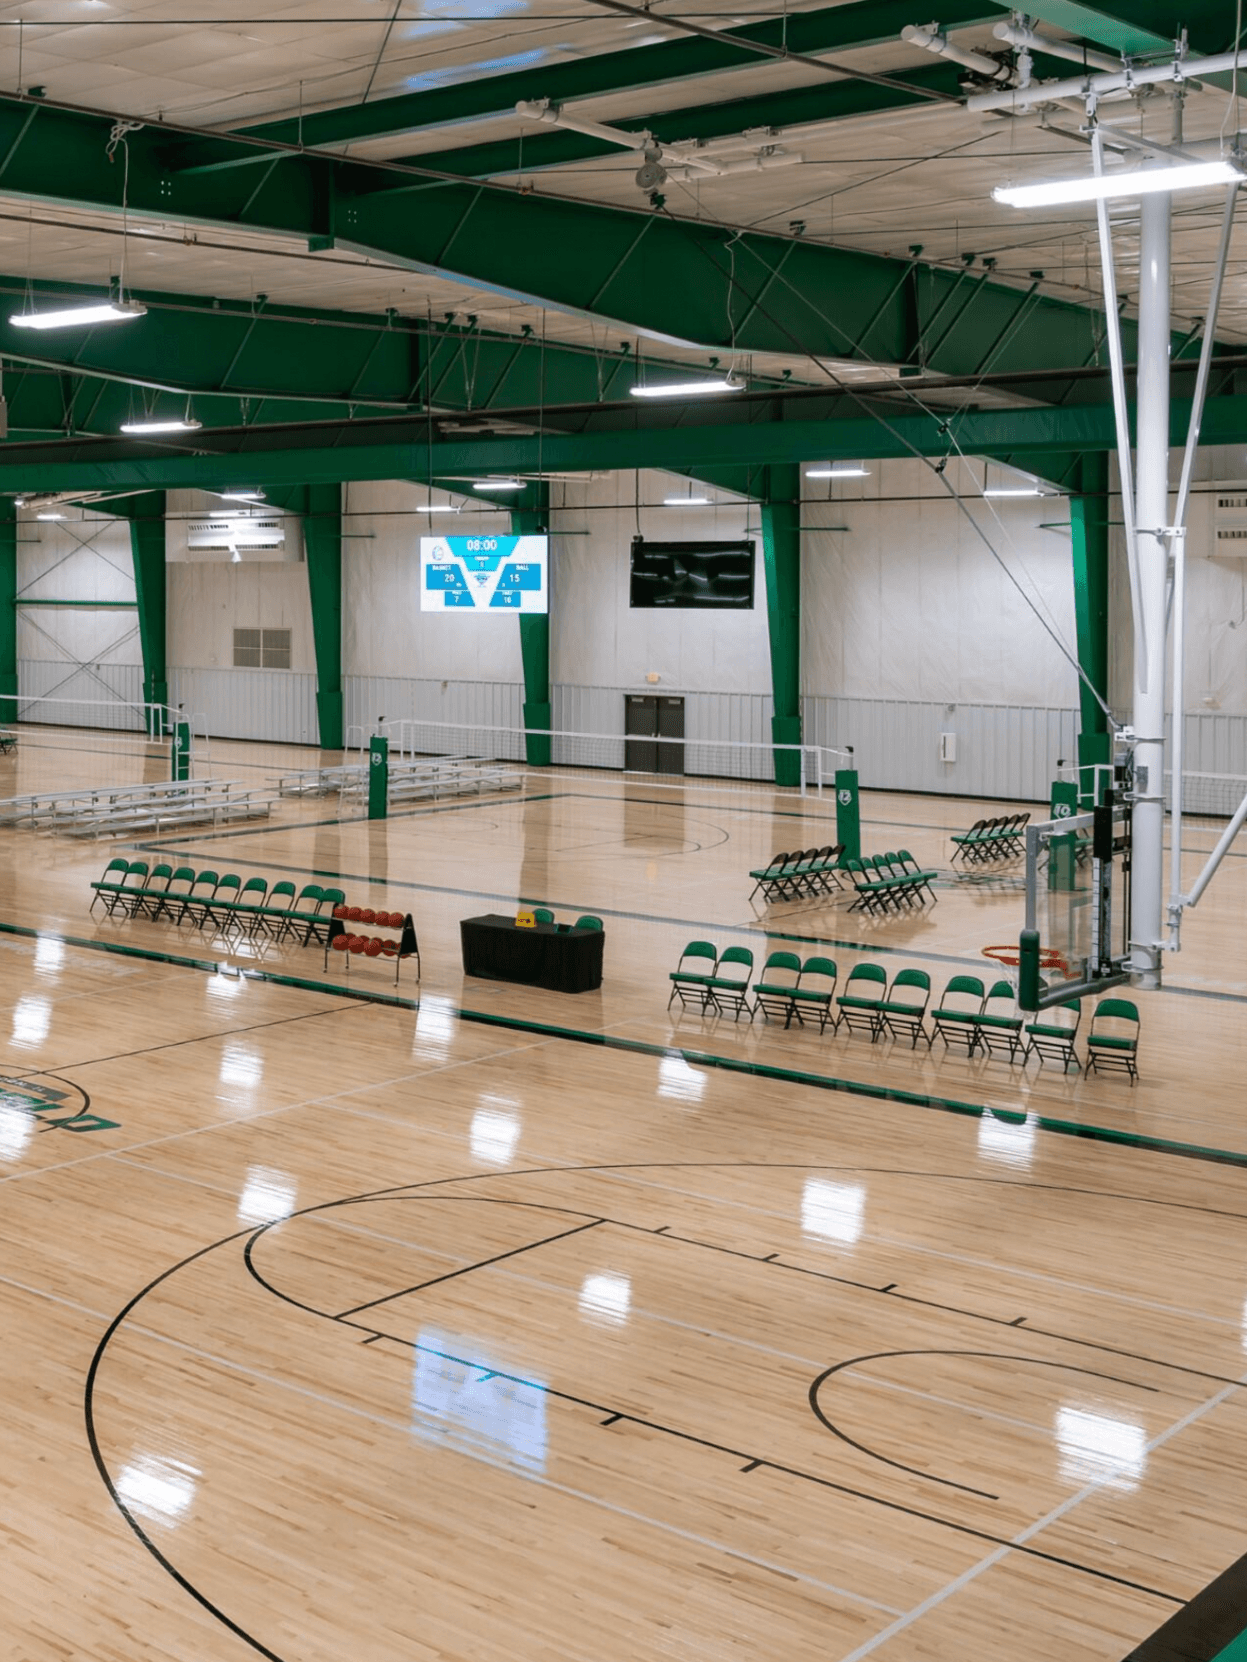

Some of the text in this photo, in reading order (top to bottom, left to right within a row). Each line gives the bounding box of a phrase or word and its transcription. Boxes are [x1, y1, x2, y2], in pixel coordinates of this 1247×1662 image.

[466, 539, 498, 551] 08:00
[444, 574, 455, 582] 20
[510, 573, 521, 582] 15
